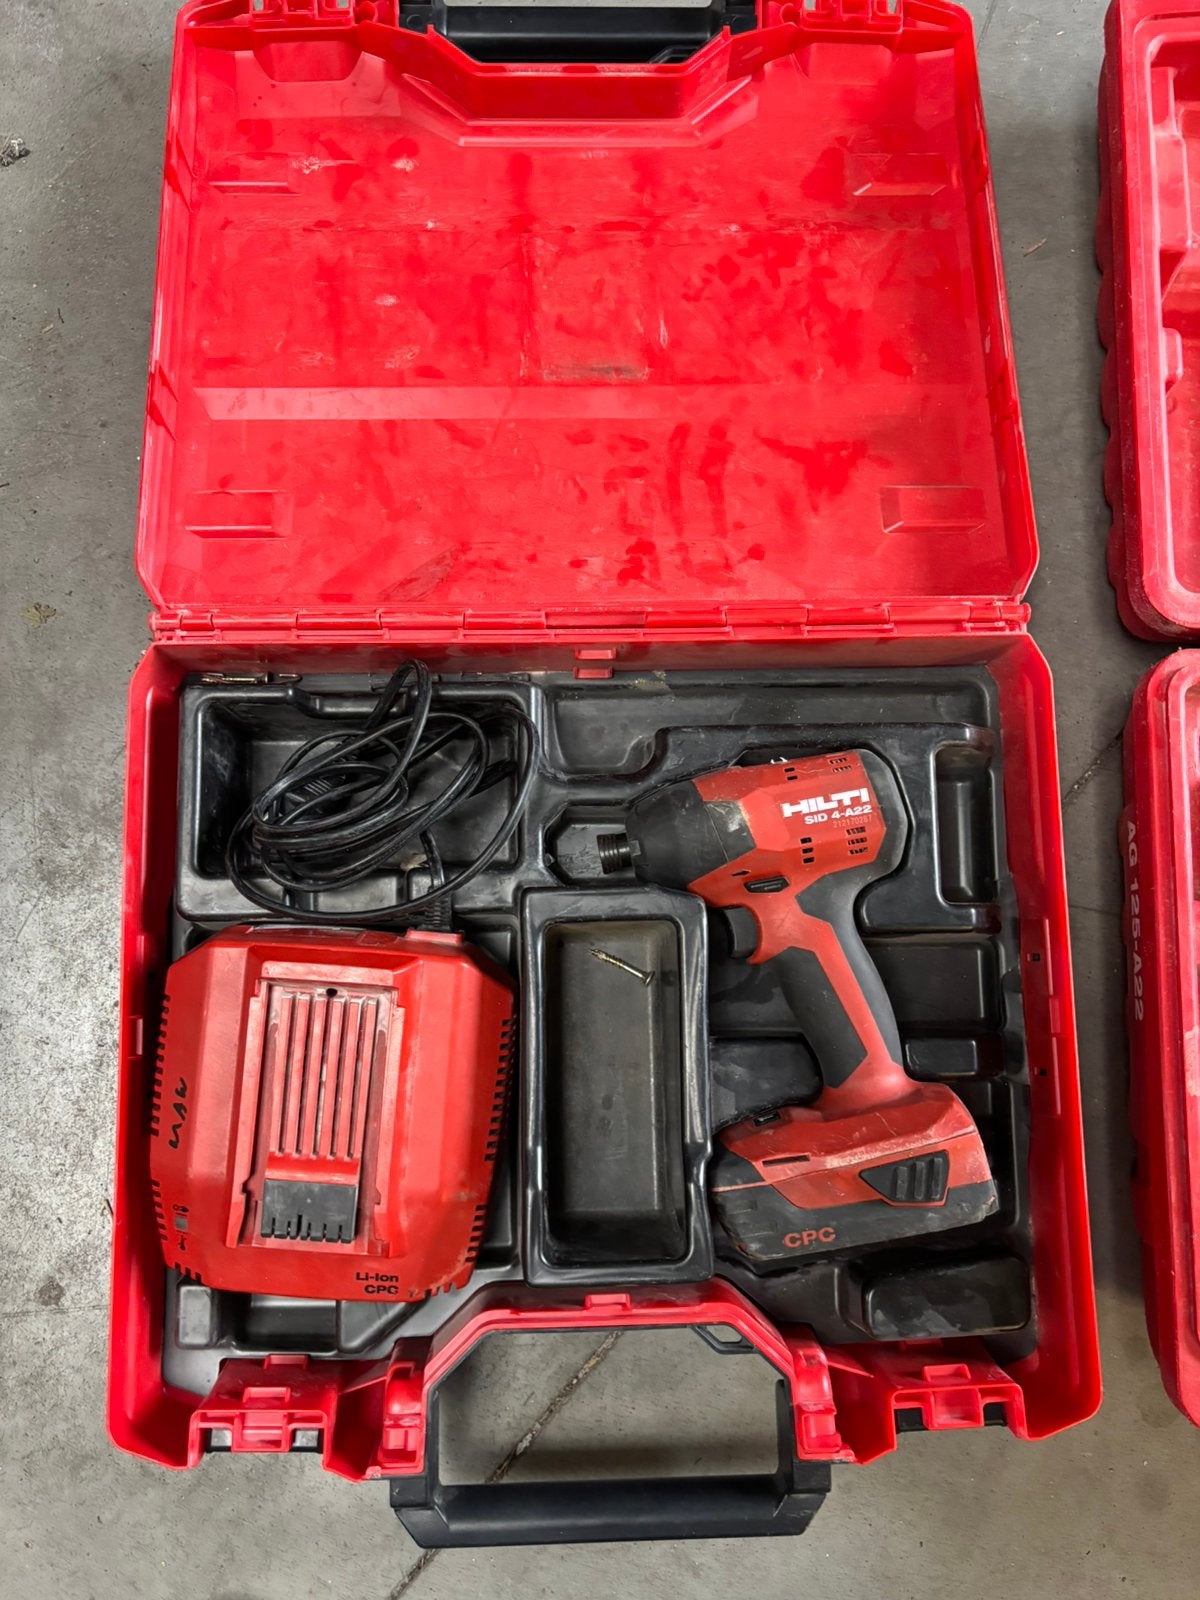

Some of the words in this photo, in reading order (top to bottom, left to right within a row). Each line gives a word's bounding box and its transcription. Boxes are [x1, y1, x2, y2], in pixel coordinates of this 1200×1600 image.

[781, 788, 870, 817] HILTI
[804, 813, 828, 825] SID
[831, 805, 872, 819] 4-A22
[1127, 820, 1138, 867] AG
[1130, 878, 1144, 1021] 125-A22
[783, 1226, 836, 1249] CPC
[364, 1284, 399, 1294] CPC
